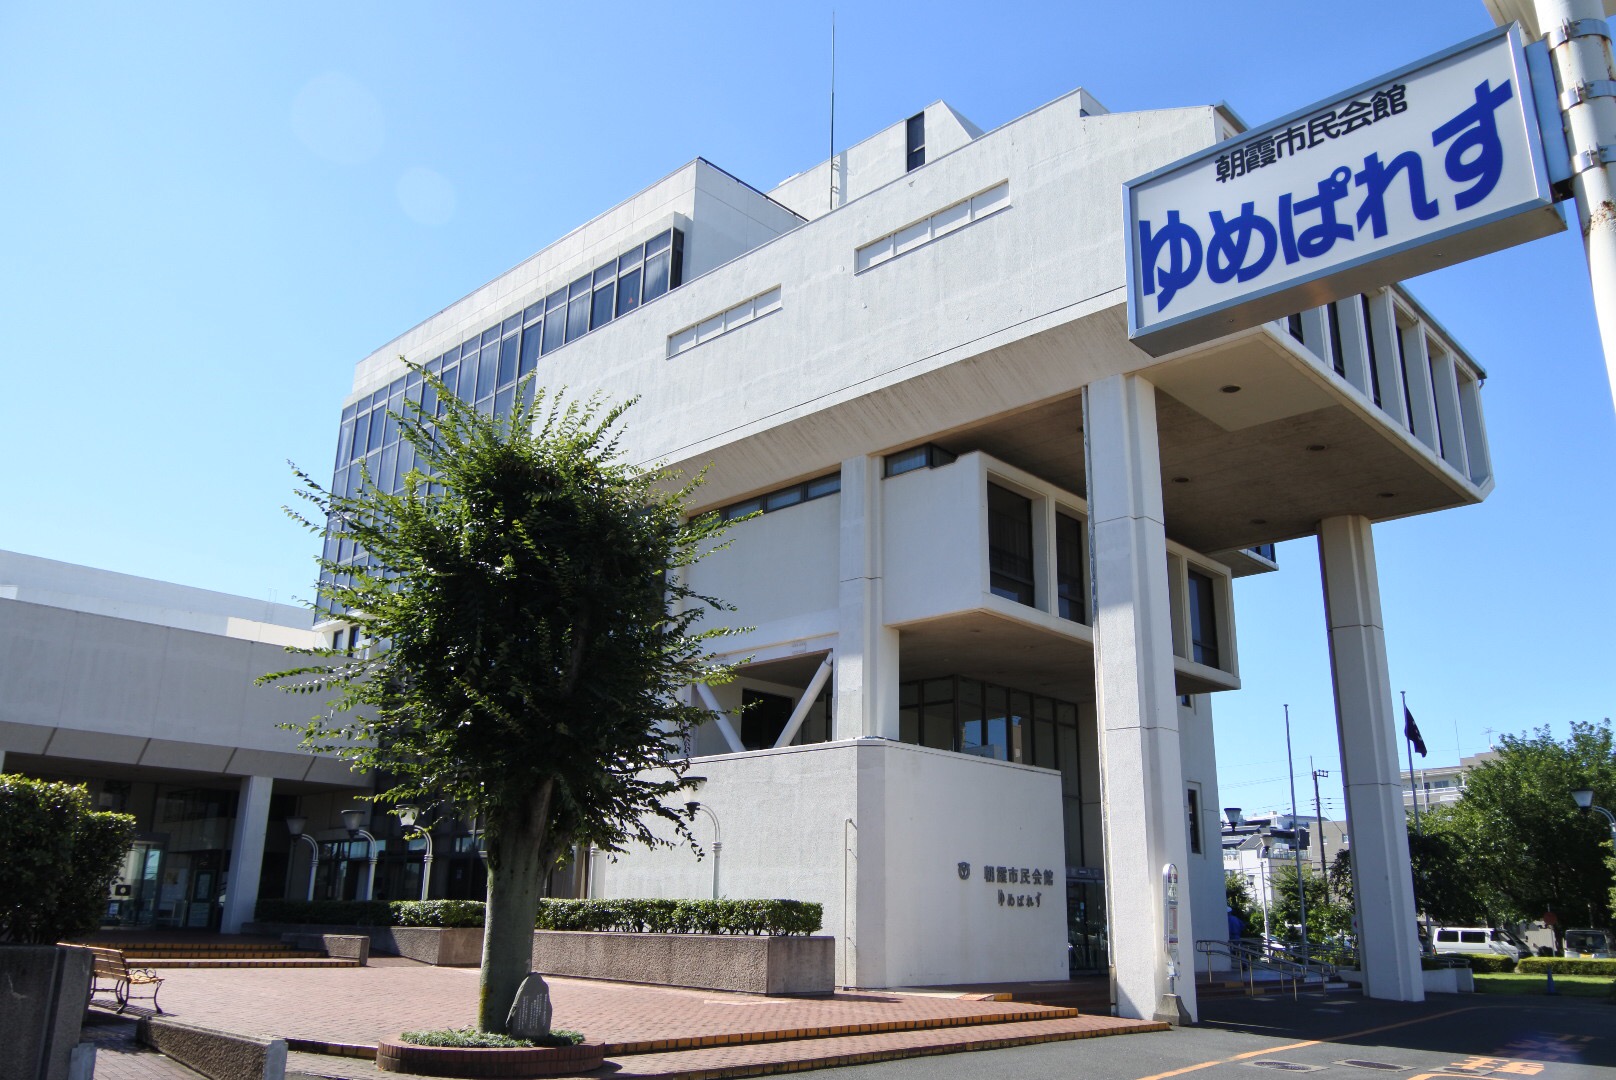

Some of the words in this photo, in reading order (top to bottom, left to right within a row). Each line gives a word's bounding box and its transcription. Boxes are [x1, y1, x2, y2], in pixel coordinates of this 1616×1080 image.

[1215, 84, 1408, 184] 朝霞市民会館
[1138, 78, 1514, 313] ゆめぱれす
[984, 865, 1054, 886] 朝霞市民会館
